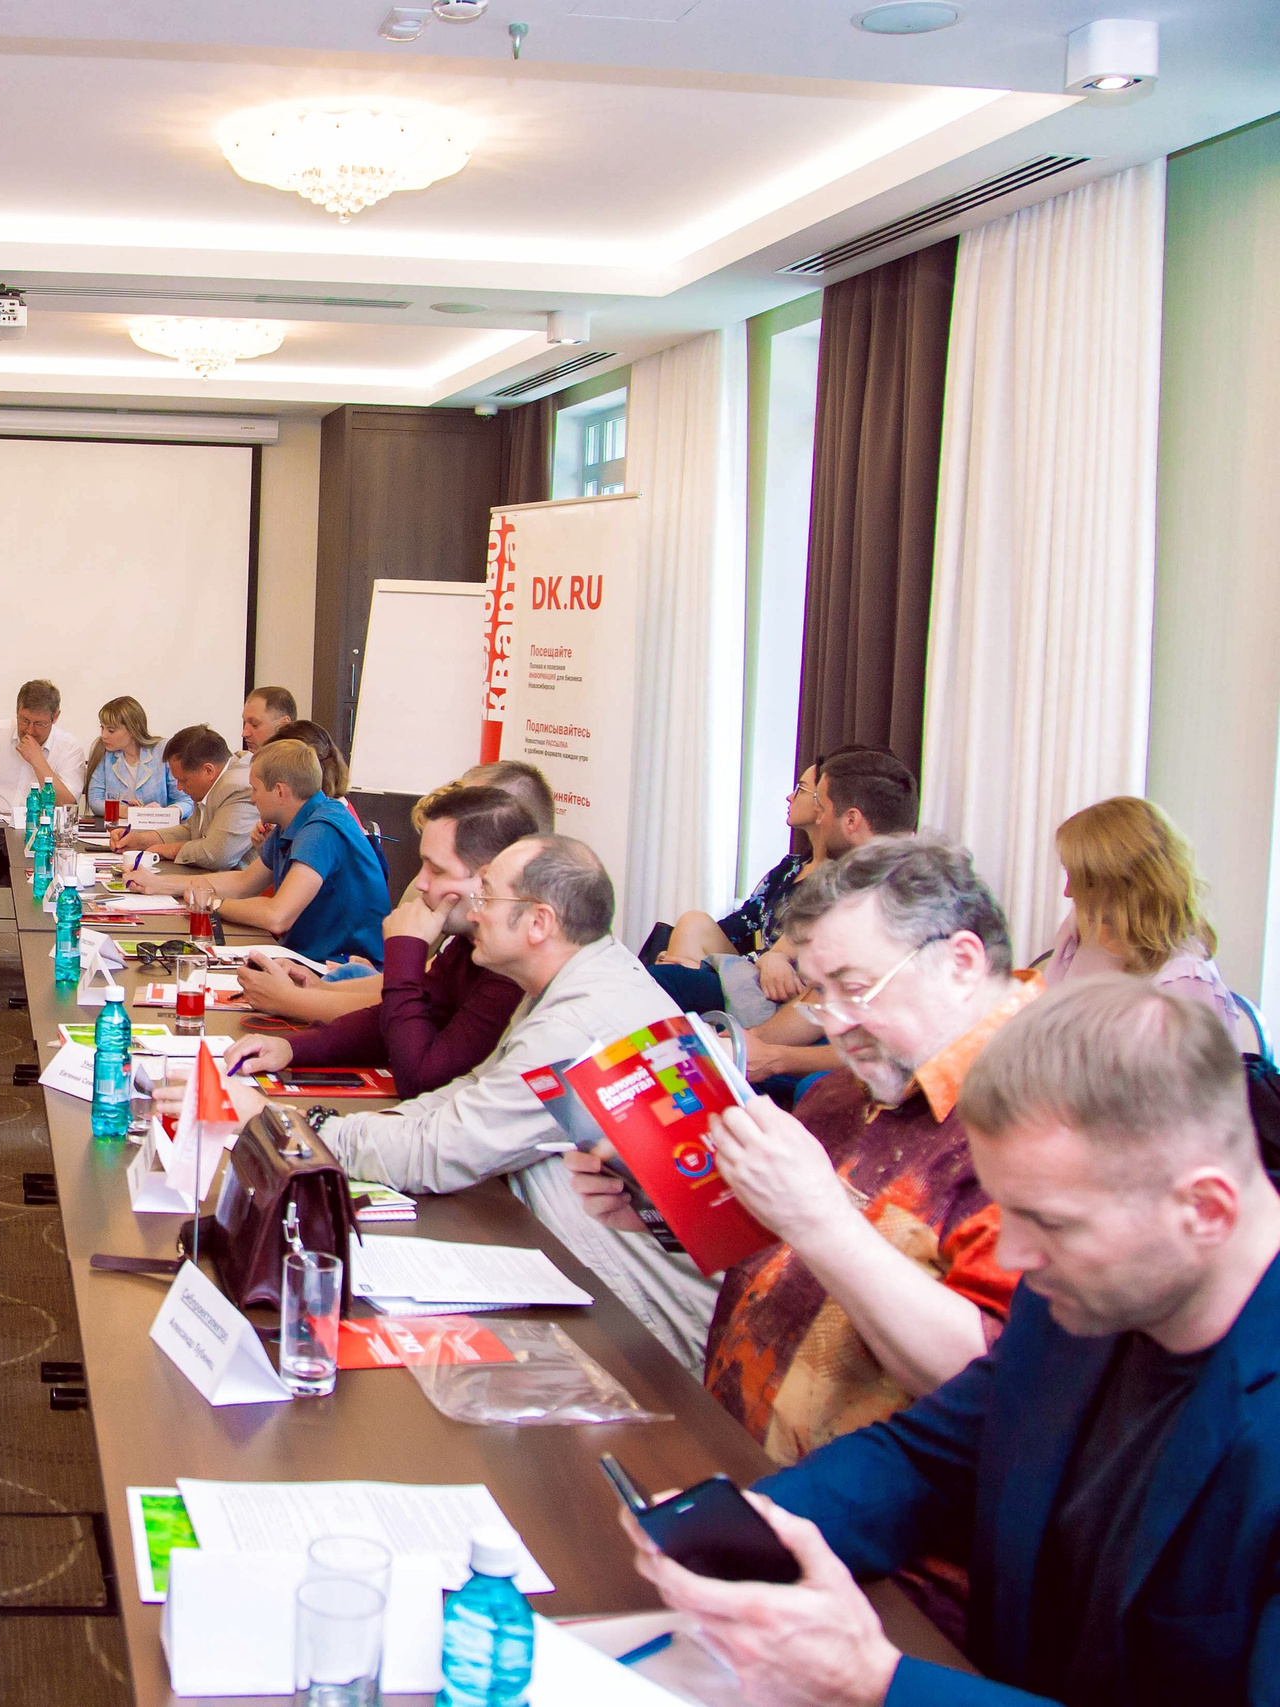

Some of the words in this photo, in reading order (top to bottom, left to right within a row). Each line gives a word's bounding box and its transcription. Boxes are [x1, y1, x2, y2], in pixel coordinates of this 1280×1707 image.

[532, 575, 603, 610] DK.RU
[531, 645, 572, 659] Посещайте
[526, 719, 591, 738] Подписывайтесь
[546, 739, 568, 748] РАССЫЛКА
[596, 1065, 650, 1098] Деловой
